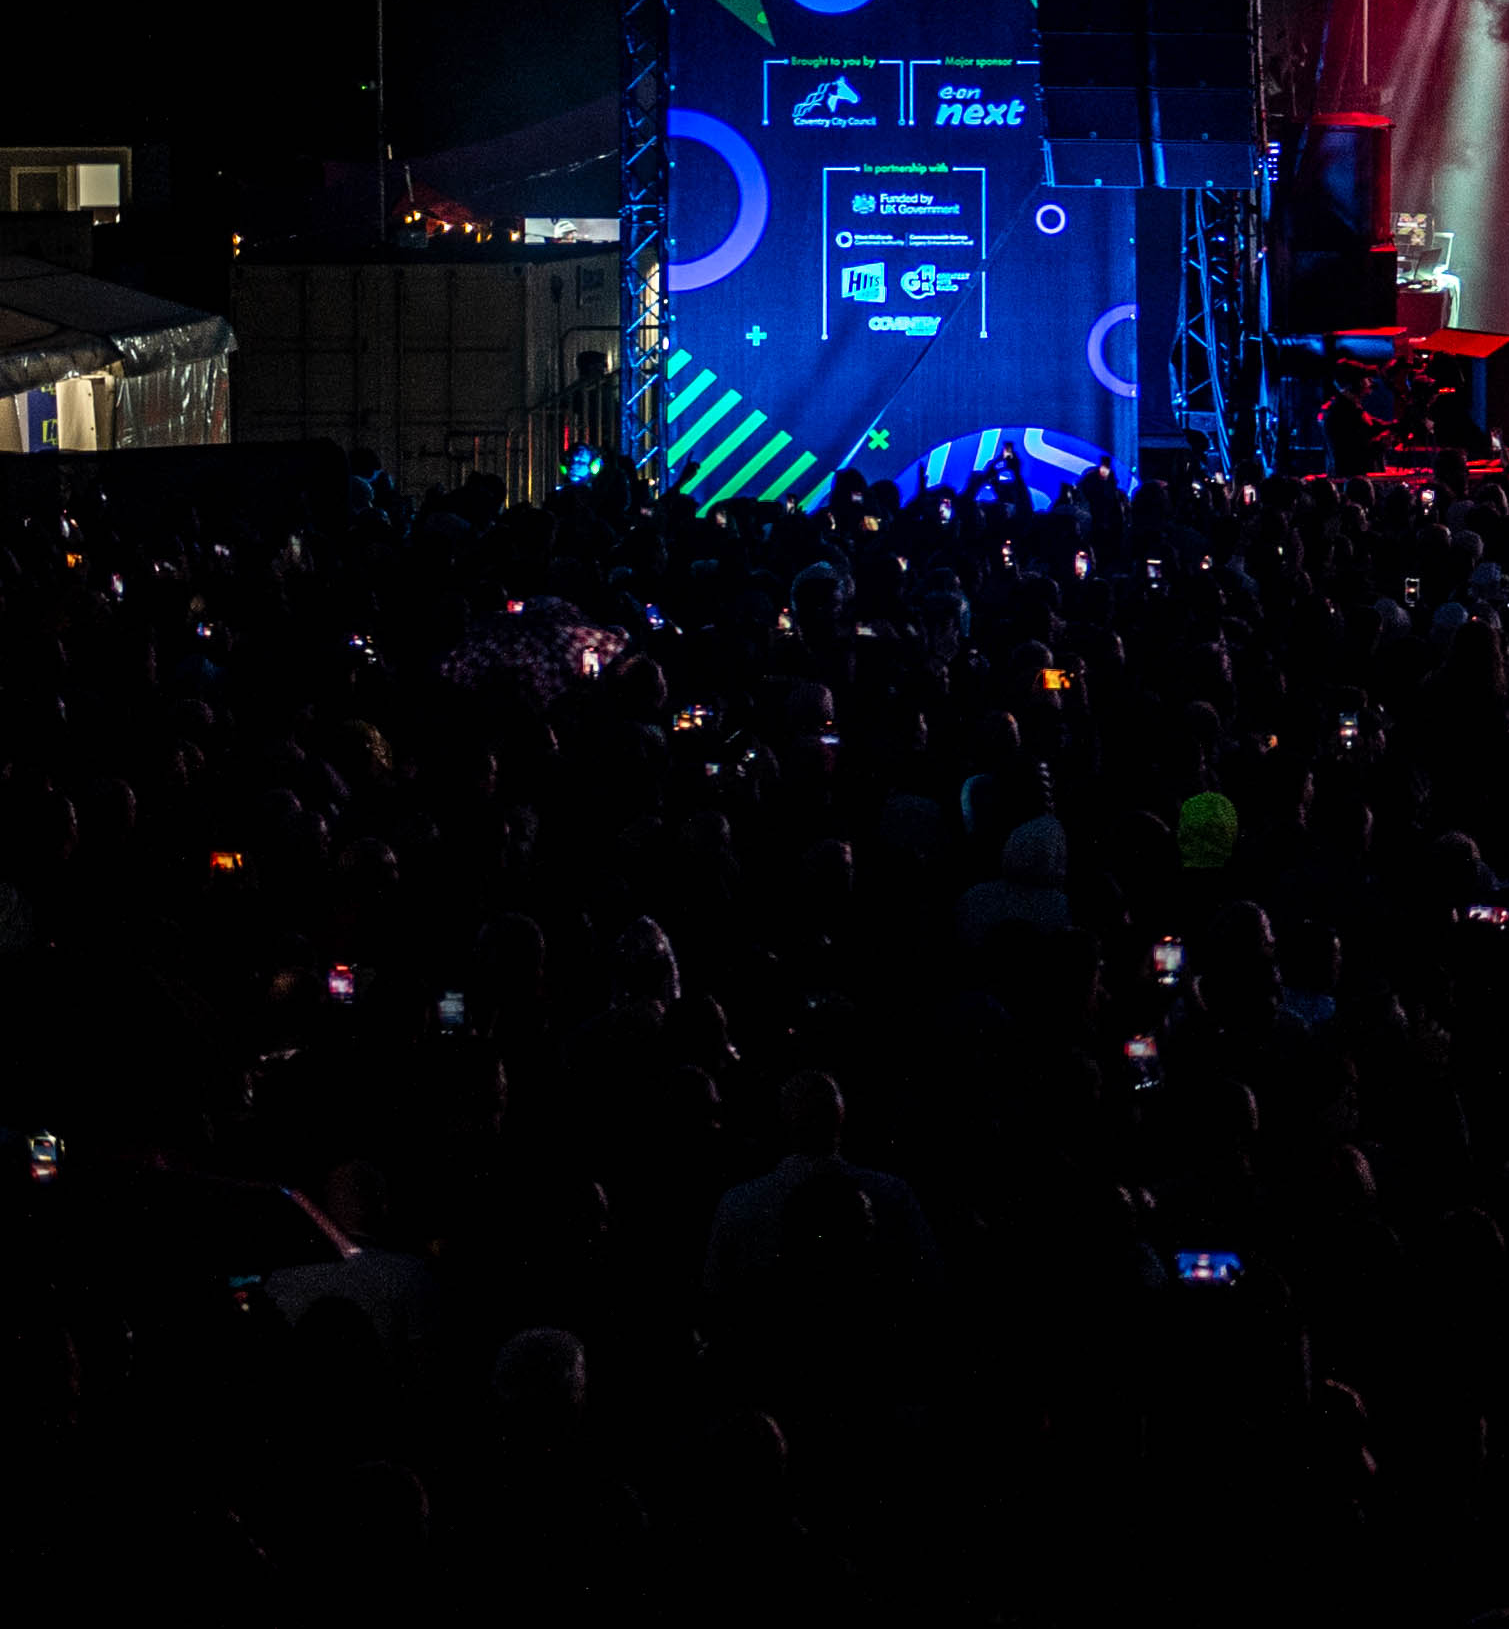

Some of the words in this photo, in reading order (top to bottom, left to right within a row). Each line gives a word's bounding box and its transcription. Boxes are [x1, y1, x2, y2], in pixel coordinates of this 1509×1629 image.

[790, 56, 829, 69] Brought
[830, 58, 841, 66] to
[842, 59, 861, 68] you
[862, 56, 877, 68] by
[944, 57, 974, 69] Major
[975, 59, 1013, 68] sponsor
[935, 99, 1025, 126] next
[880, 193, 918, 203] Funded
[920, 193, 933, 205] by
[880, 204, 897, 214] UK
[898, 204, 960, 215] Government
